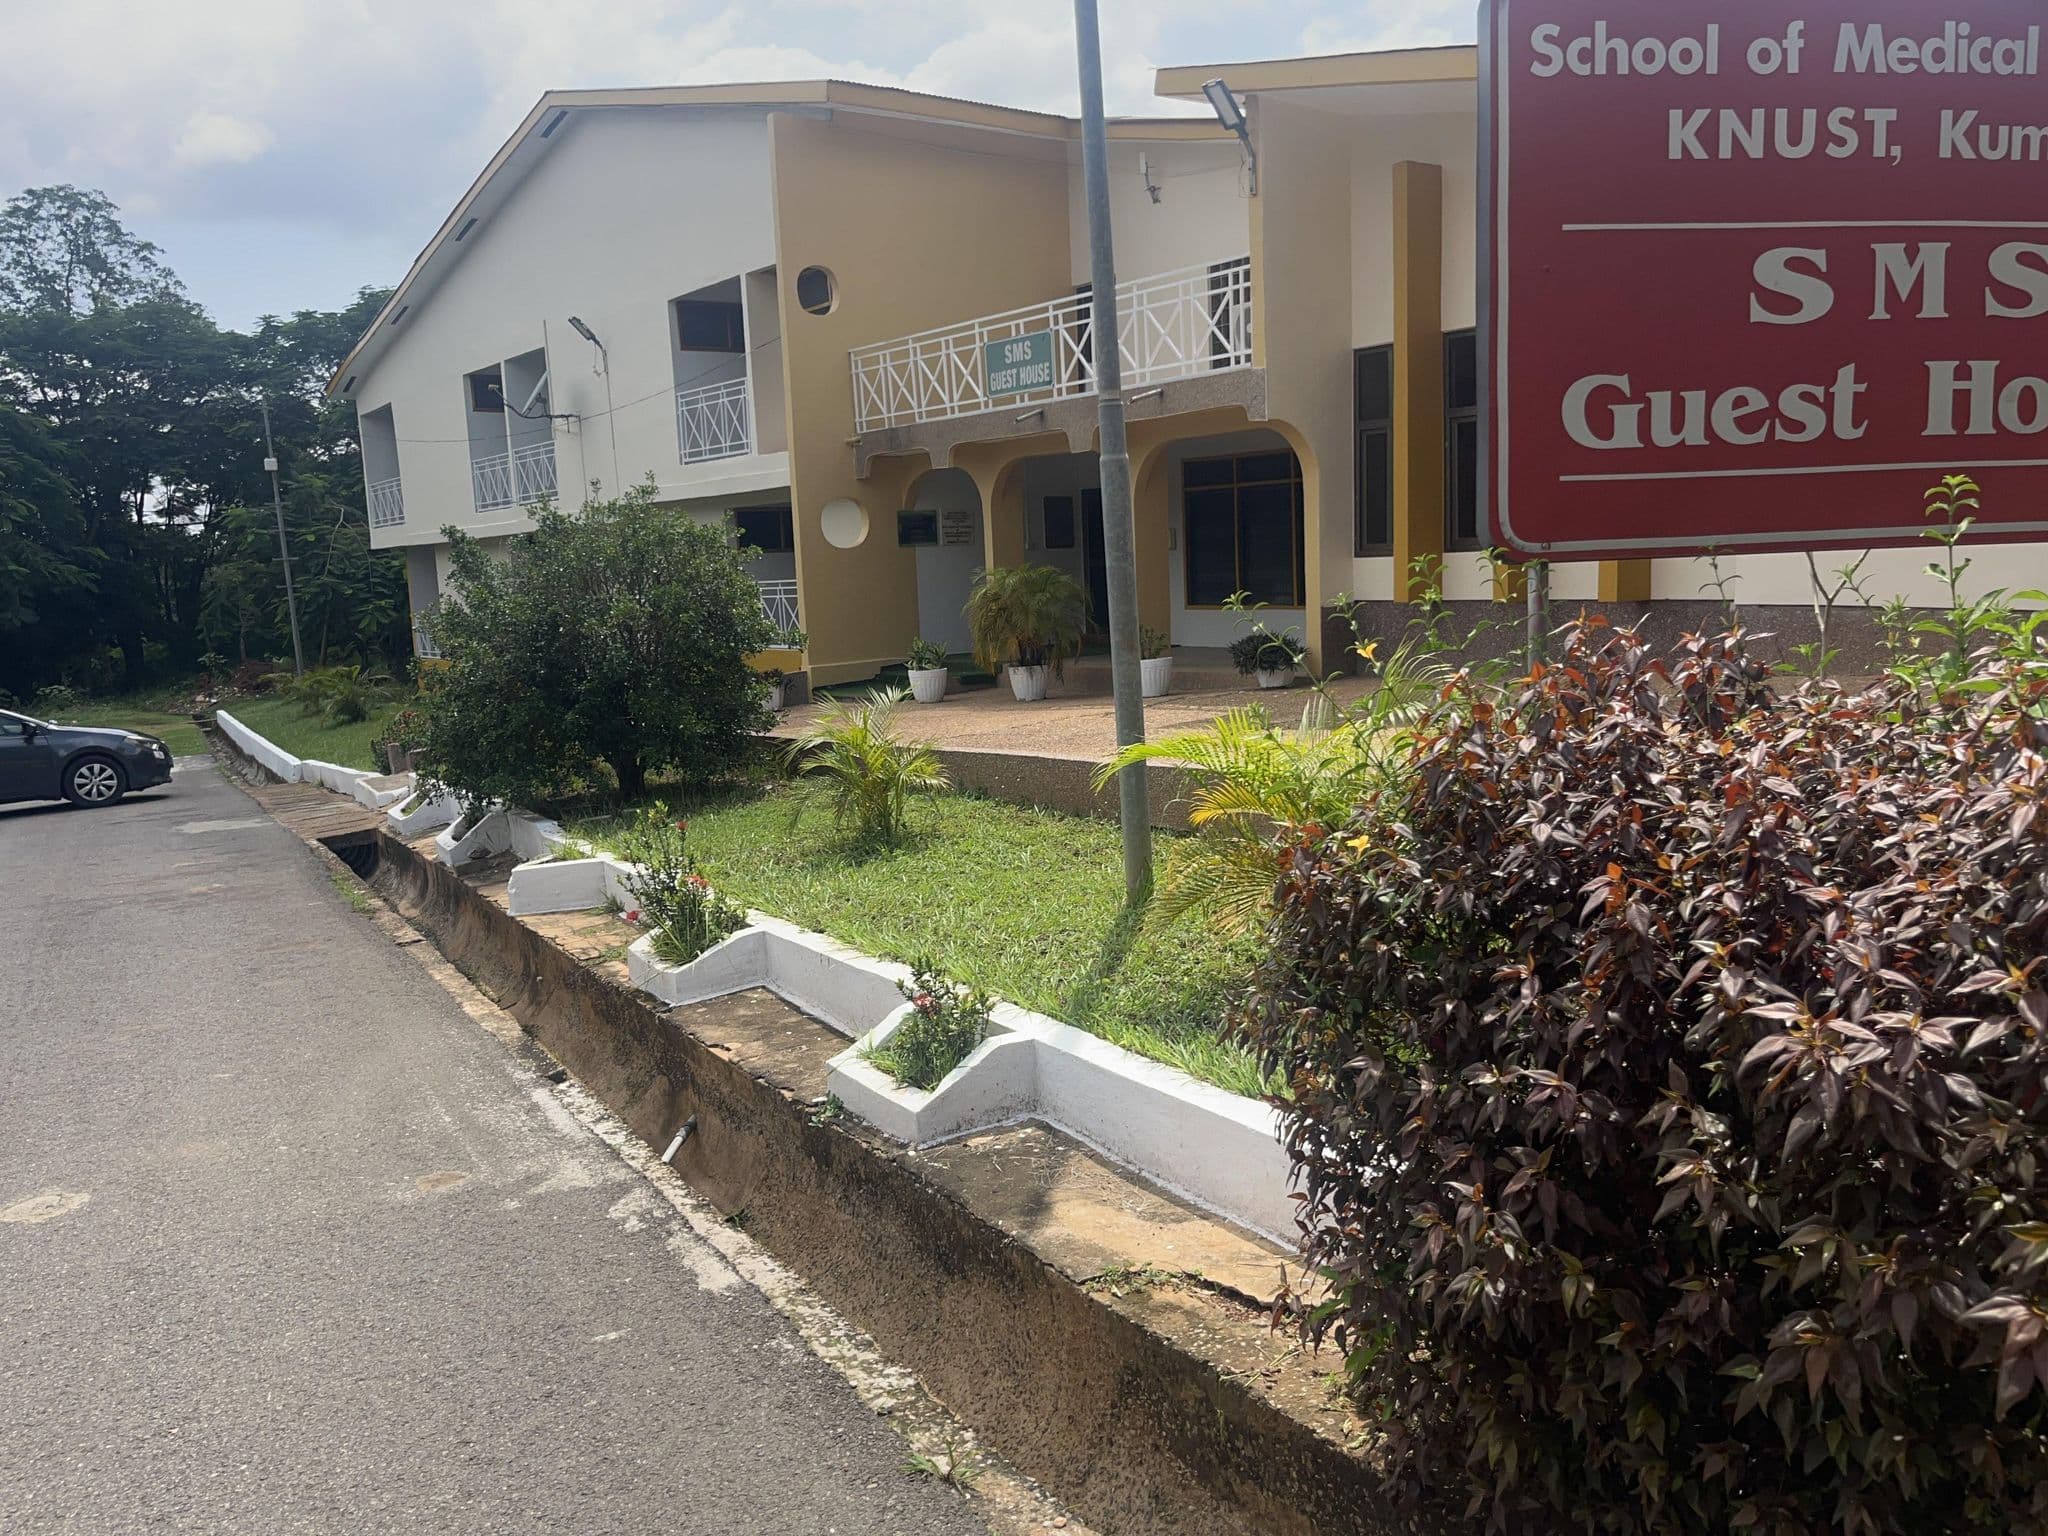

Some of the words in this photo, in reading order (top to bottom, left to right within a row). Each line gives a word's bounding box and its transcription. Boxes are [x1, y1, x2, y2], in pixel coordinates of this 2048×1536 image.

[1530, 20, 1719, 77] School
[1746, 21, 1805, 75] of
[1833, 21, 2040, 75] Medical
[1668, 107, 1902, 166] KNUST,
[990, 368, 1018, 391] GUEST
[1019, 362, 1050, 386] HOUSE
[1004, 340, 1032, 364] SMS
[1561, 362, 1869, 450] Guest
[1920, 360, 2048, 436] Ho
